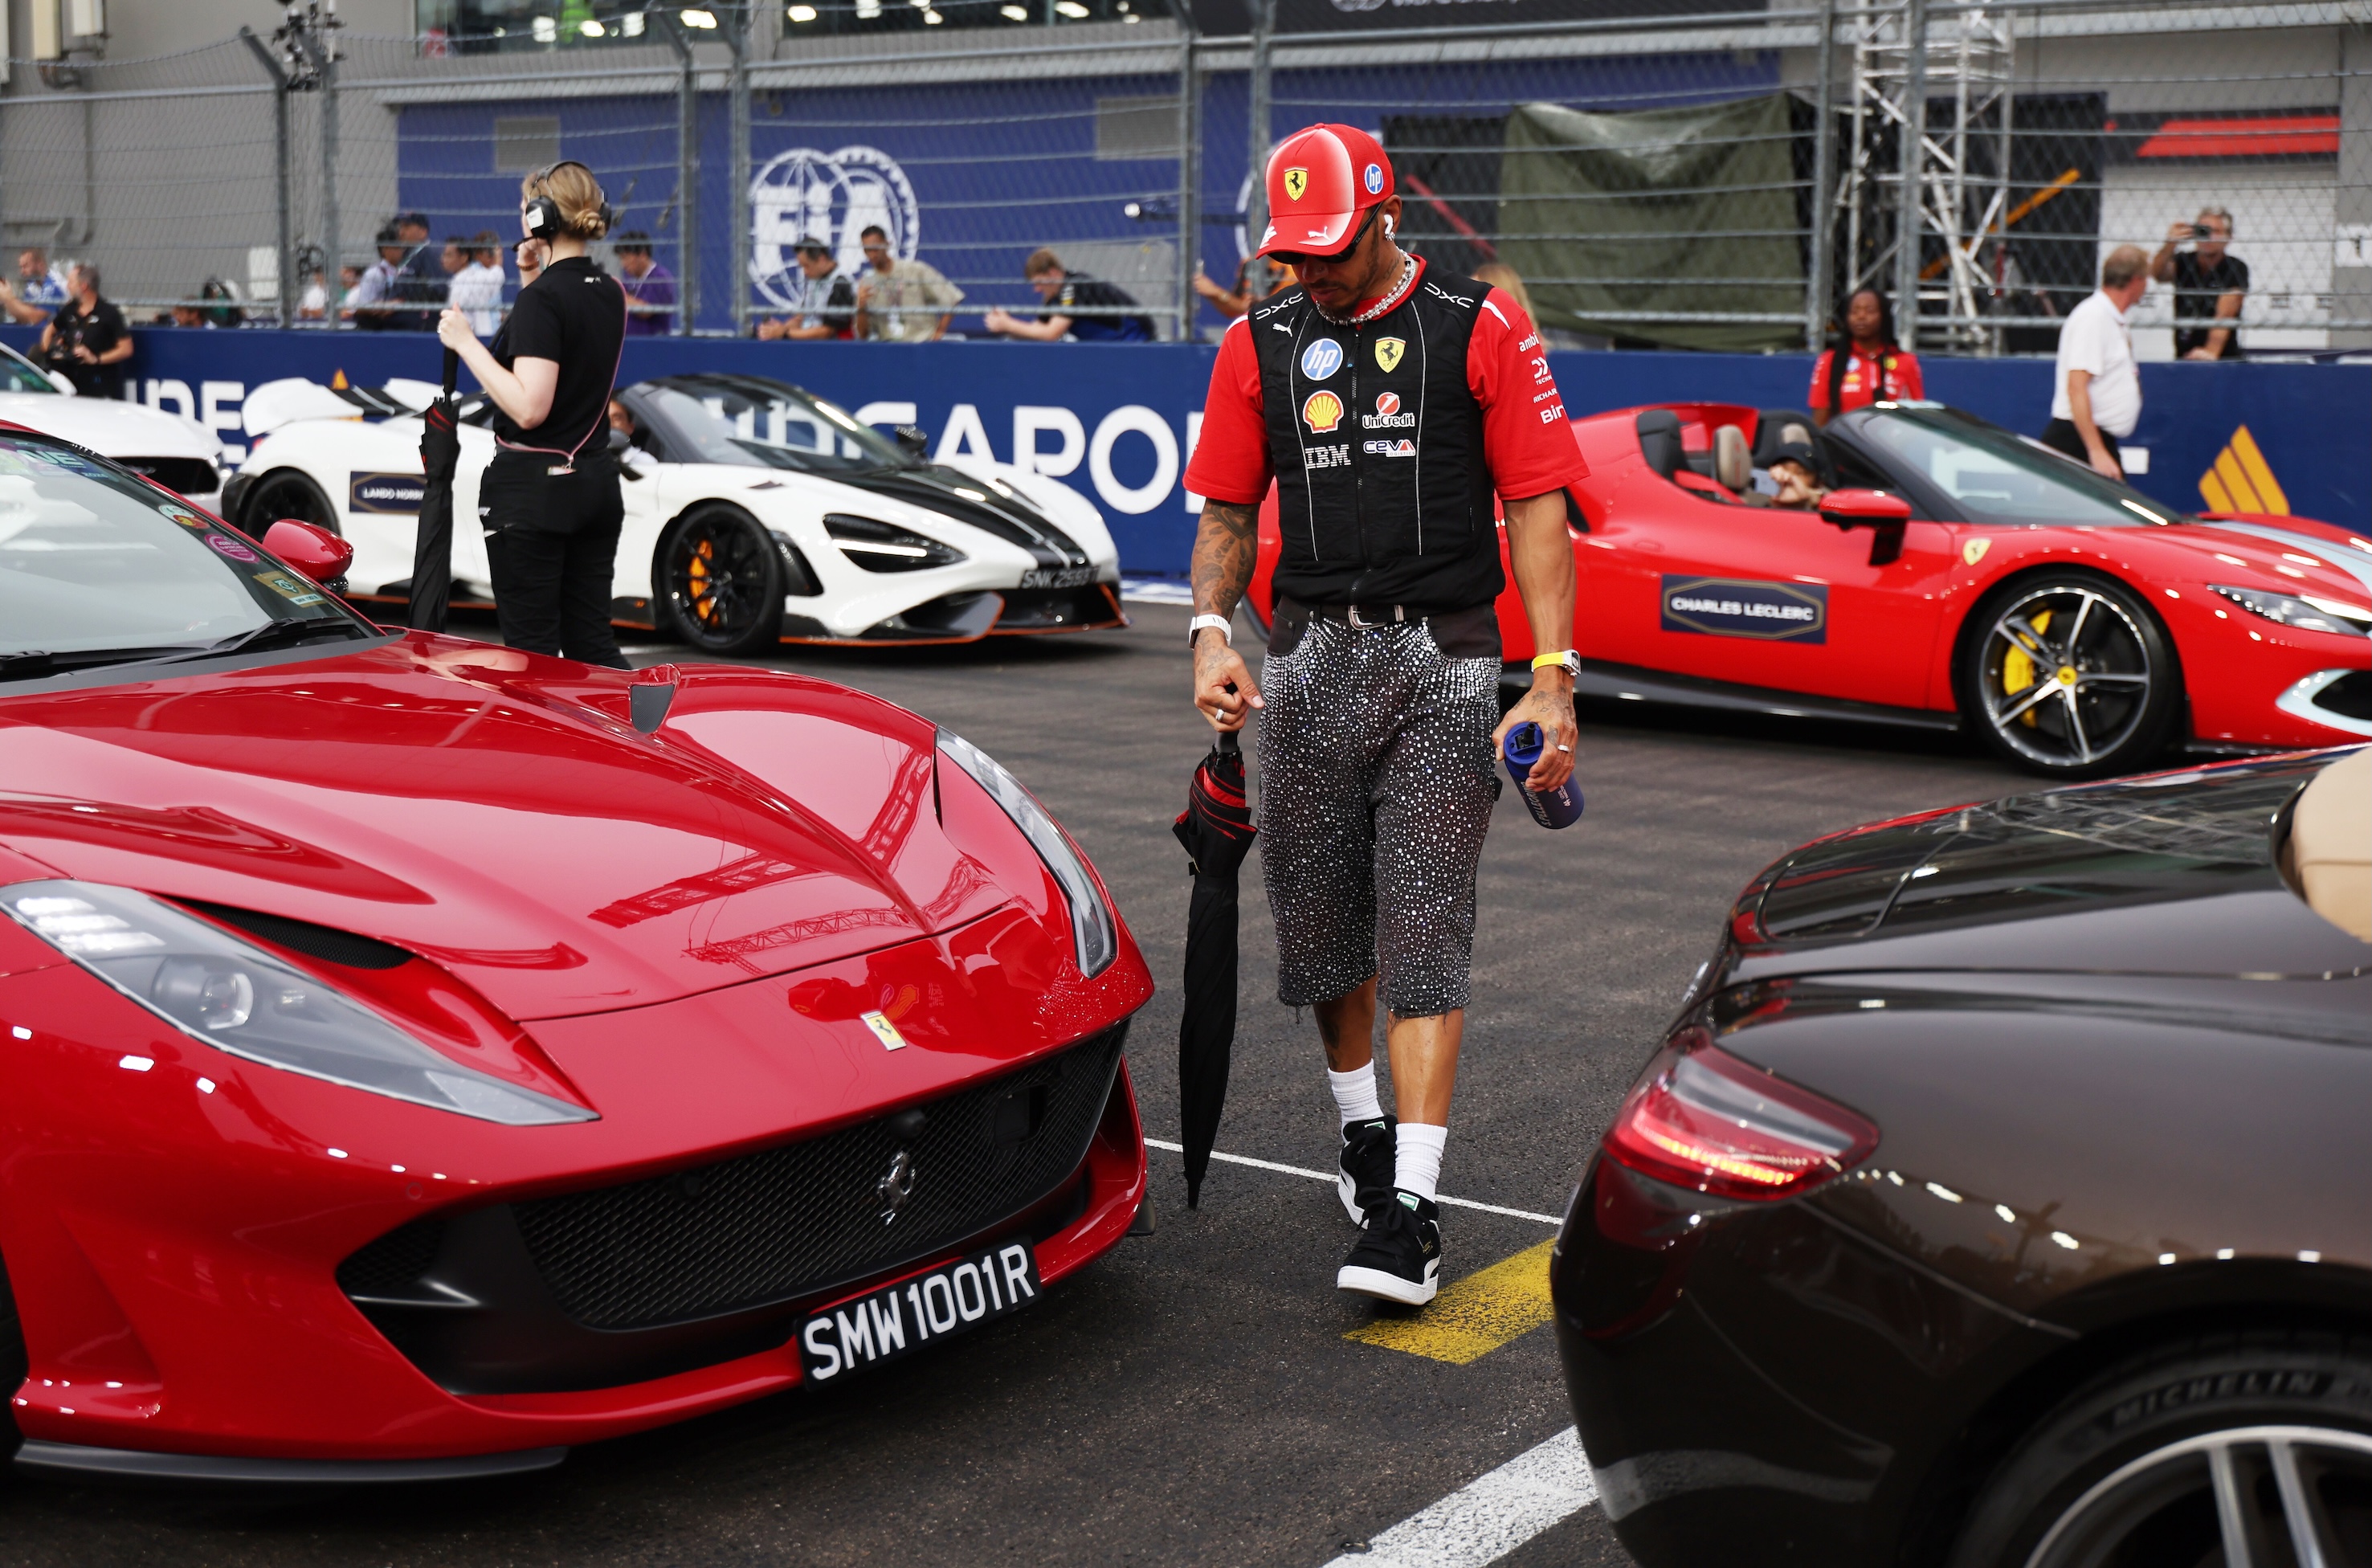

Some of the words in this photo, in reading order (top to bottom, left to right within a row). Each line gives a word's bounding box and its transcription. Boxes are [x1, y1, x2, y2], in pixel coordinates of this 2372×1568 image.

[1305, 339, 1339, 380] hp
[1363, 414, 1415, 428] UniCredit
[1304, 444, 1351, 469] IBM
[363, 487, 395, 500] LANDO
[396, 489, 425, 501] NORRI
[1671, 597, 1742, 615] CHARLES
[1743, 603, 1815, 622] LECLERC
[2112, 1373, 2317, 1427] MICHELIN
